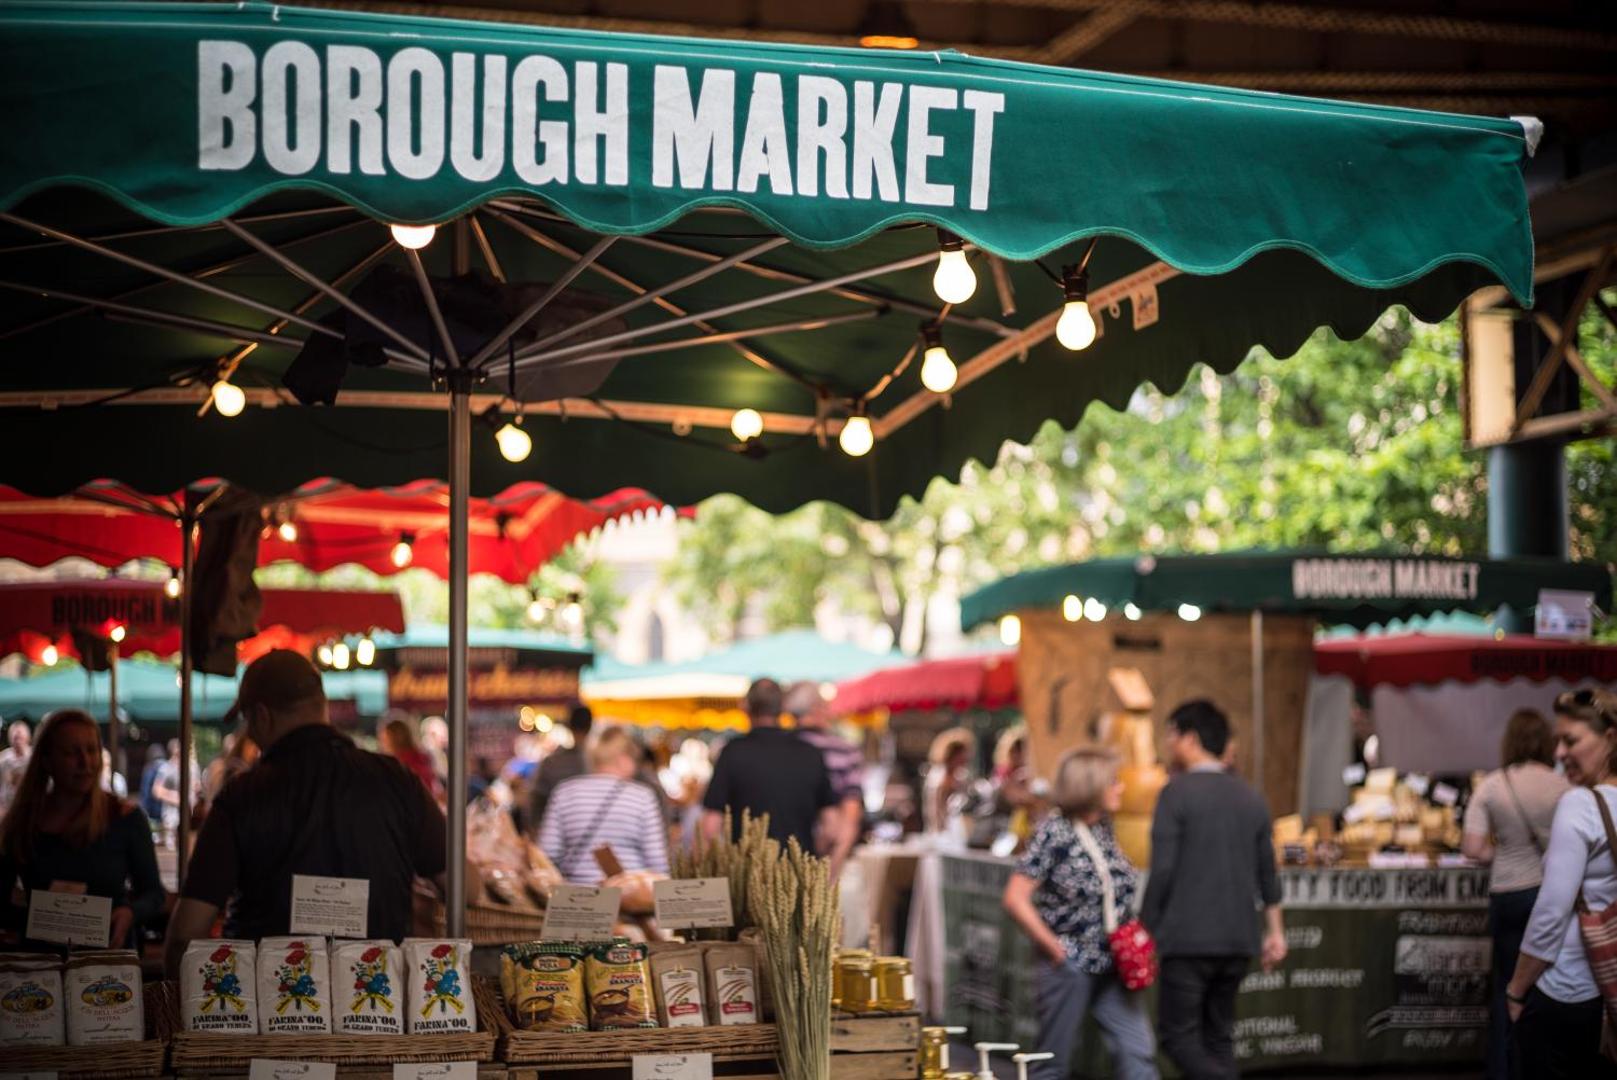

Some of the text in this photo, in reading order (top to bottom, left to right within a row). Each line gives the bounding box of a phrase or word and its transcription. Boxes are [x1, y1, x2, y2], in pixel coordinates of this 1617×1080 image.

[197, 38, 1005, 211] BOROUGH MARKET
[1293, 559, 1480, 600] BOROUGH MARKET
[52, 594, 155, 625] BOROUGH
[1330, 871, 1387, 900] FOOD
[1395, 871, 1448, 900] FROM
[193, 1014, 228, 1024] FARINA
[268, 1015, 304, 1025] FARINA
[343, 1015, 378, 1024] FARINA
[414, 1020, 448, 1031] FARINA
